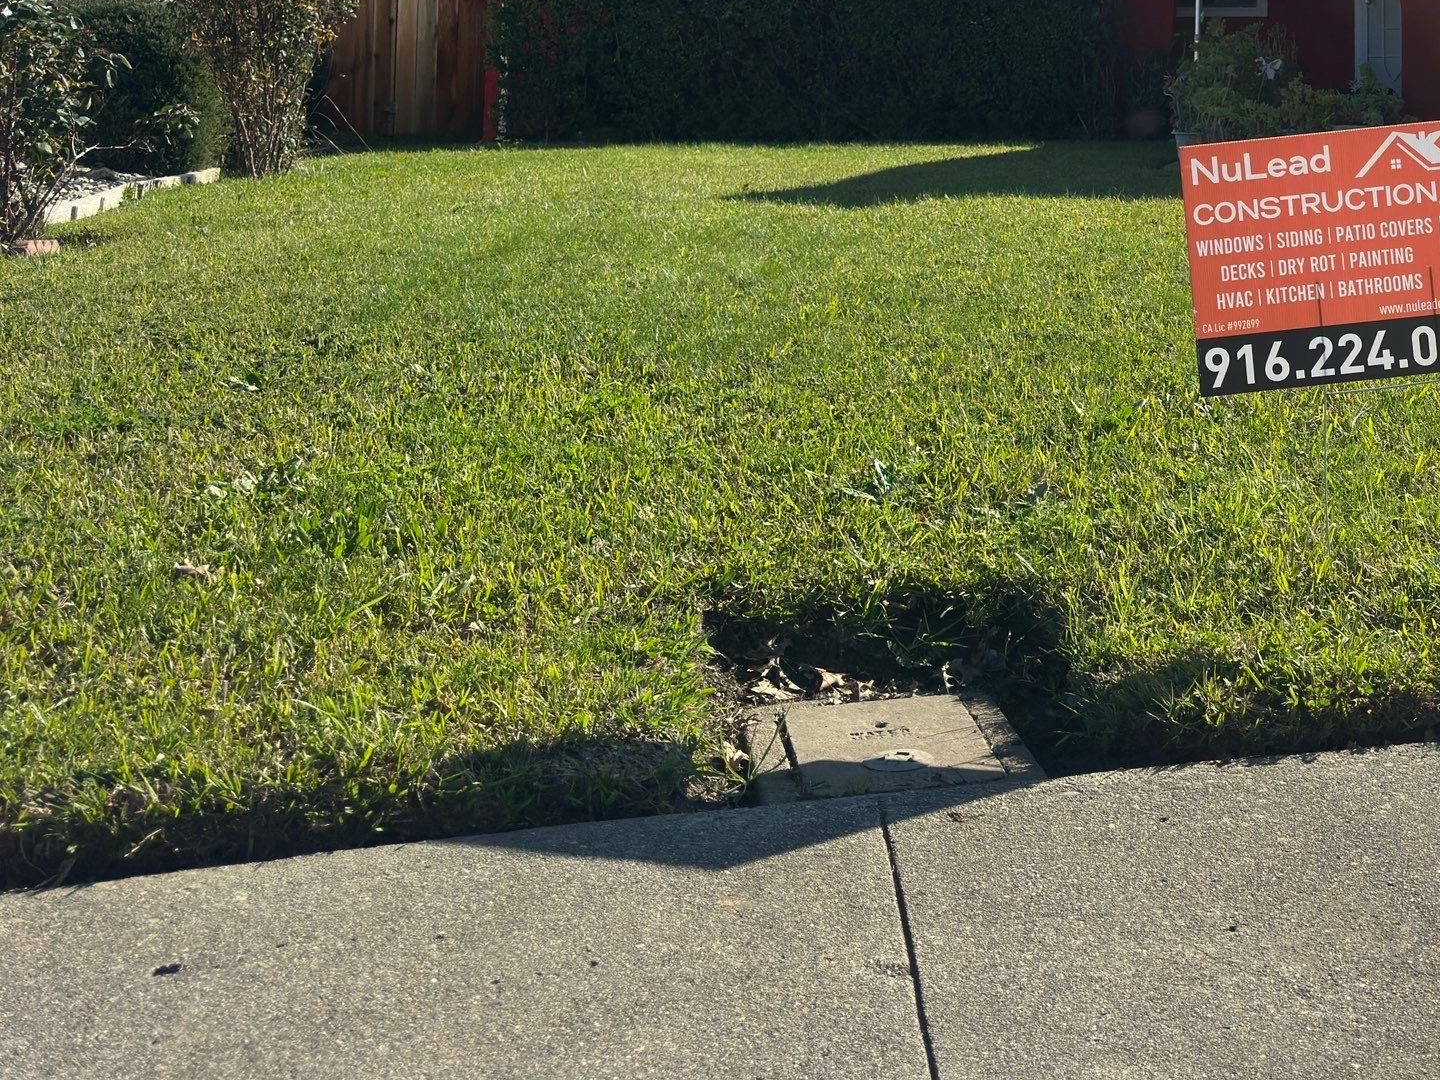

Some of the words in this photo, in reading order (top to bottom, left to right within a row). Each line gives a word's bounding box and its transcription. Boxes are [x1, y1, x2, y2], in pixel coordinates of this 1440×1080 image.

[1190, 144, 1332, 186] NuLead
[1195, 234, 1265, 258] WINDOWS
[1276, 228, 1323, 249] SIDING
[1335, 223, 1376, 244] PATIO
[1379, 217, 1434, 239] COVERS
[1220, 261, 1266, 282] DECKS
[1278, 257, 1305, 276] DRY
[1310, 254, 1337, 273] ROT
[1349, 247, 1414, 269] PAINTING
[1216, 290, 1254, 310] HVAC
[1265, 282, 1326, 305] KITCHEN
[1337, 273, 1424, 299] BATHROOMS
[1202, 323, 1214, 334] CA
[1215, 322, 1226, 332] Lic
[1227, 318, 1260, 331] #992899
